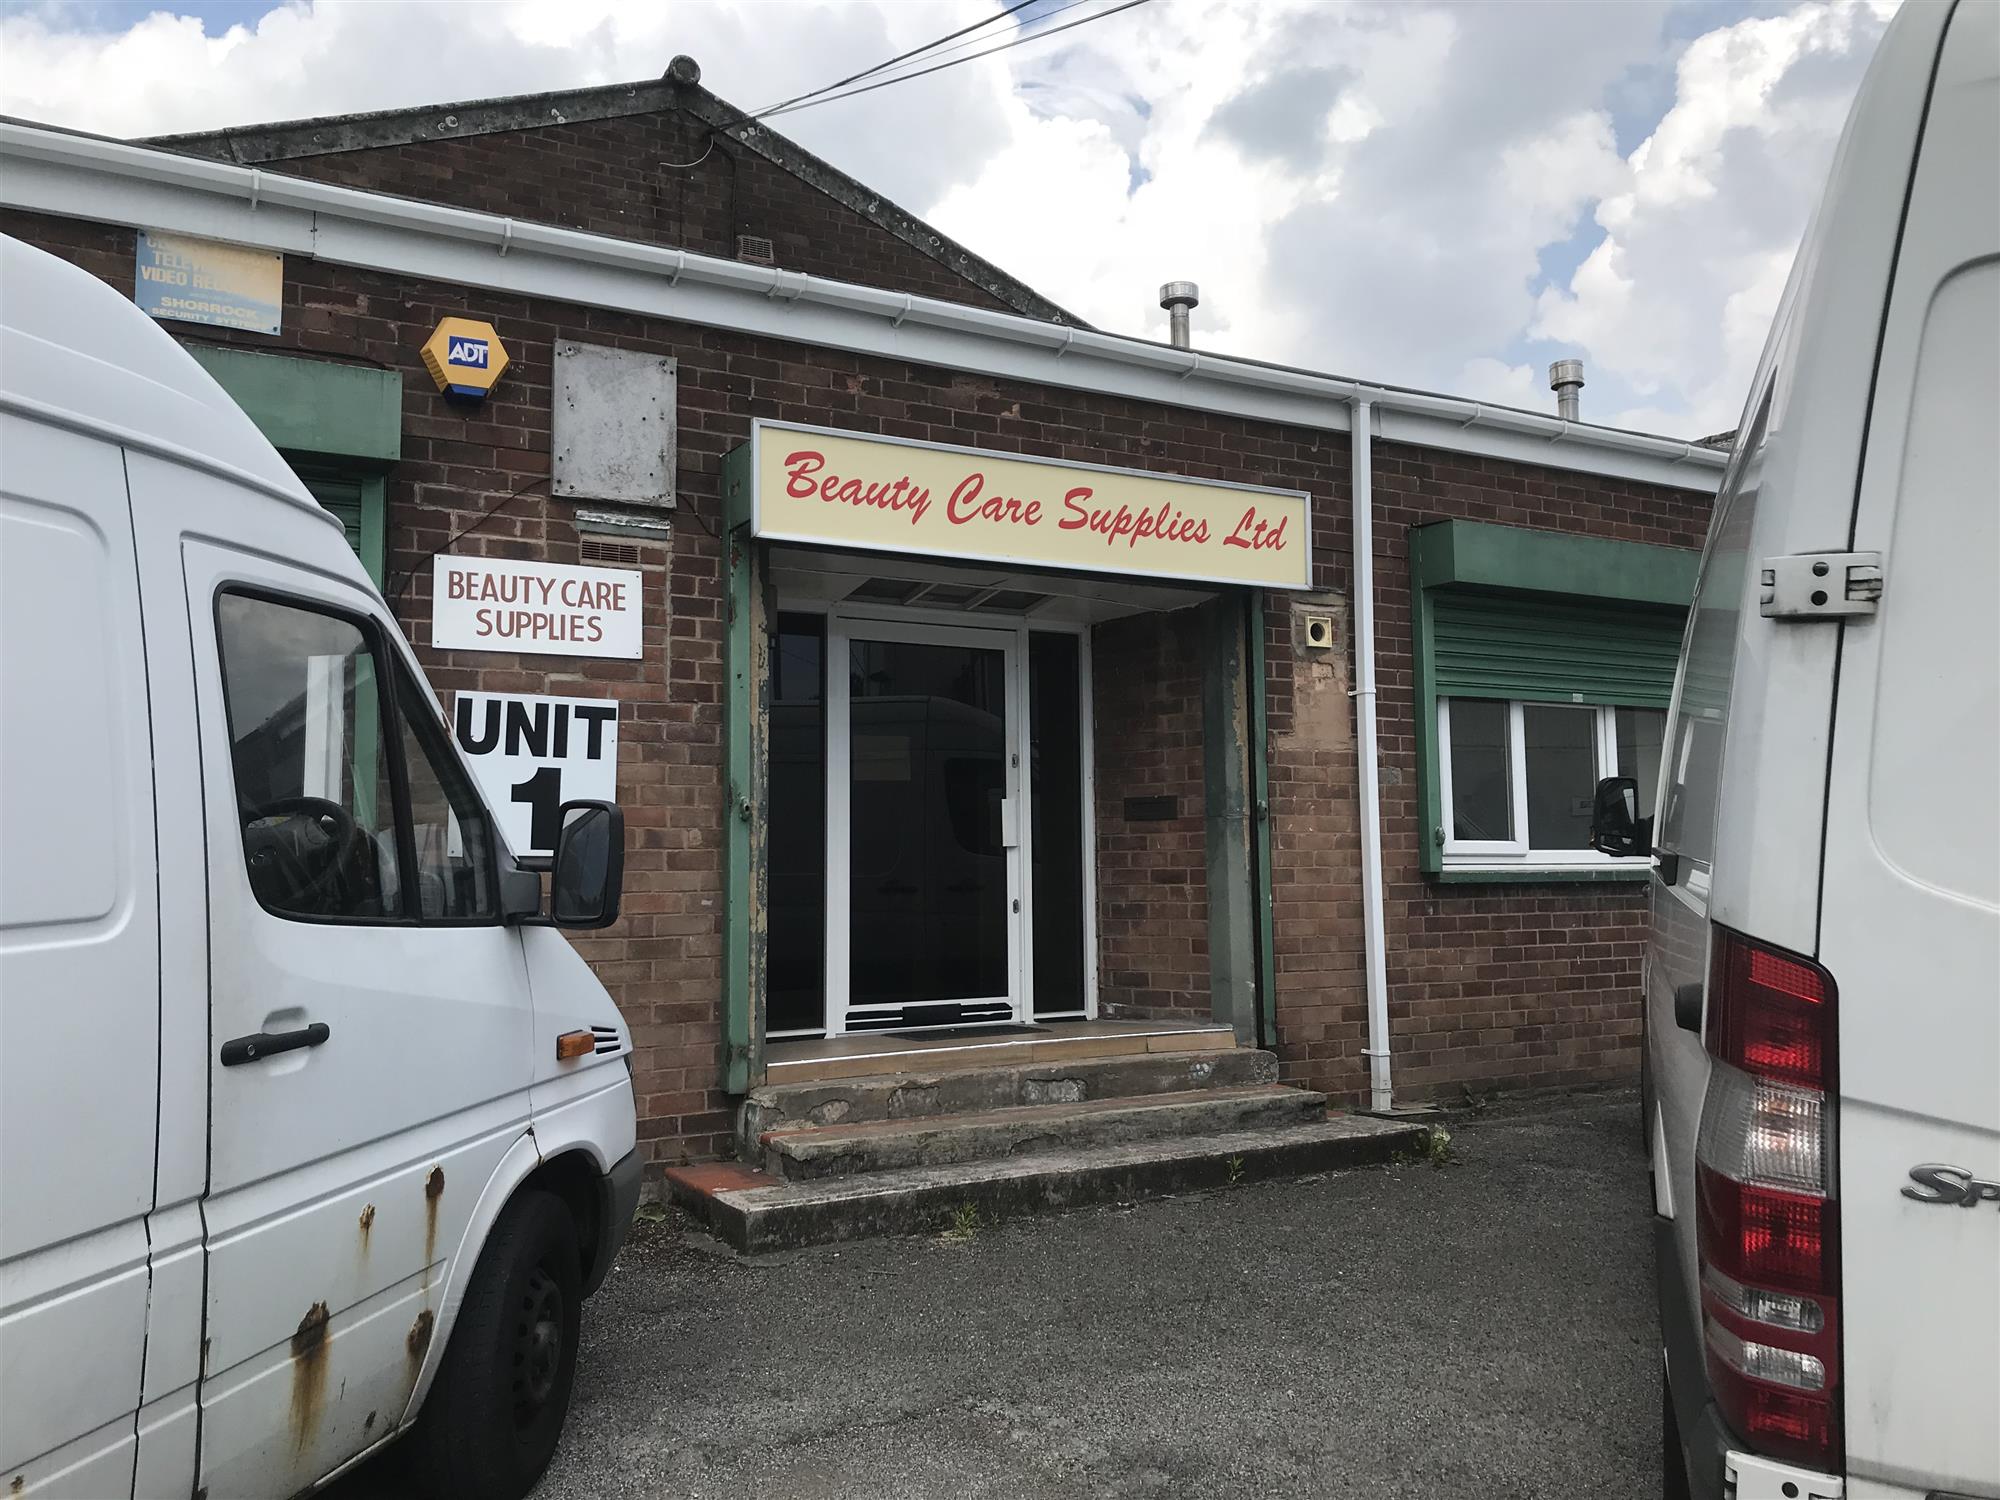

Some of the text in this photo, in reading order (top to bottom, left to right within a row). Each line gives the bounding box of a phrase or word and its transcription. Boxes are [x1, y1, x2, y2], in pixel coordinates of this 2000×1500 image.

[141, 265, 188, 287] VIDEO
[151, 306, 209, 322] SECURITY
[160, 296, 257, 320] SHORROCK
[448, 341, 488, 364] ADT
[784, 451, 1288, 550] Beauty Care Supplies Ltd
[448, 570, 627, 612] BEAUTY CARE
[476, 608, 604, 642] SUPPLIES
[456, 697, 617, 761] UNIT
[511, 767, 562, 851] 1
